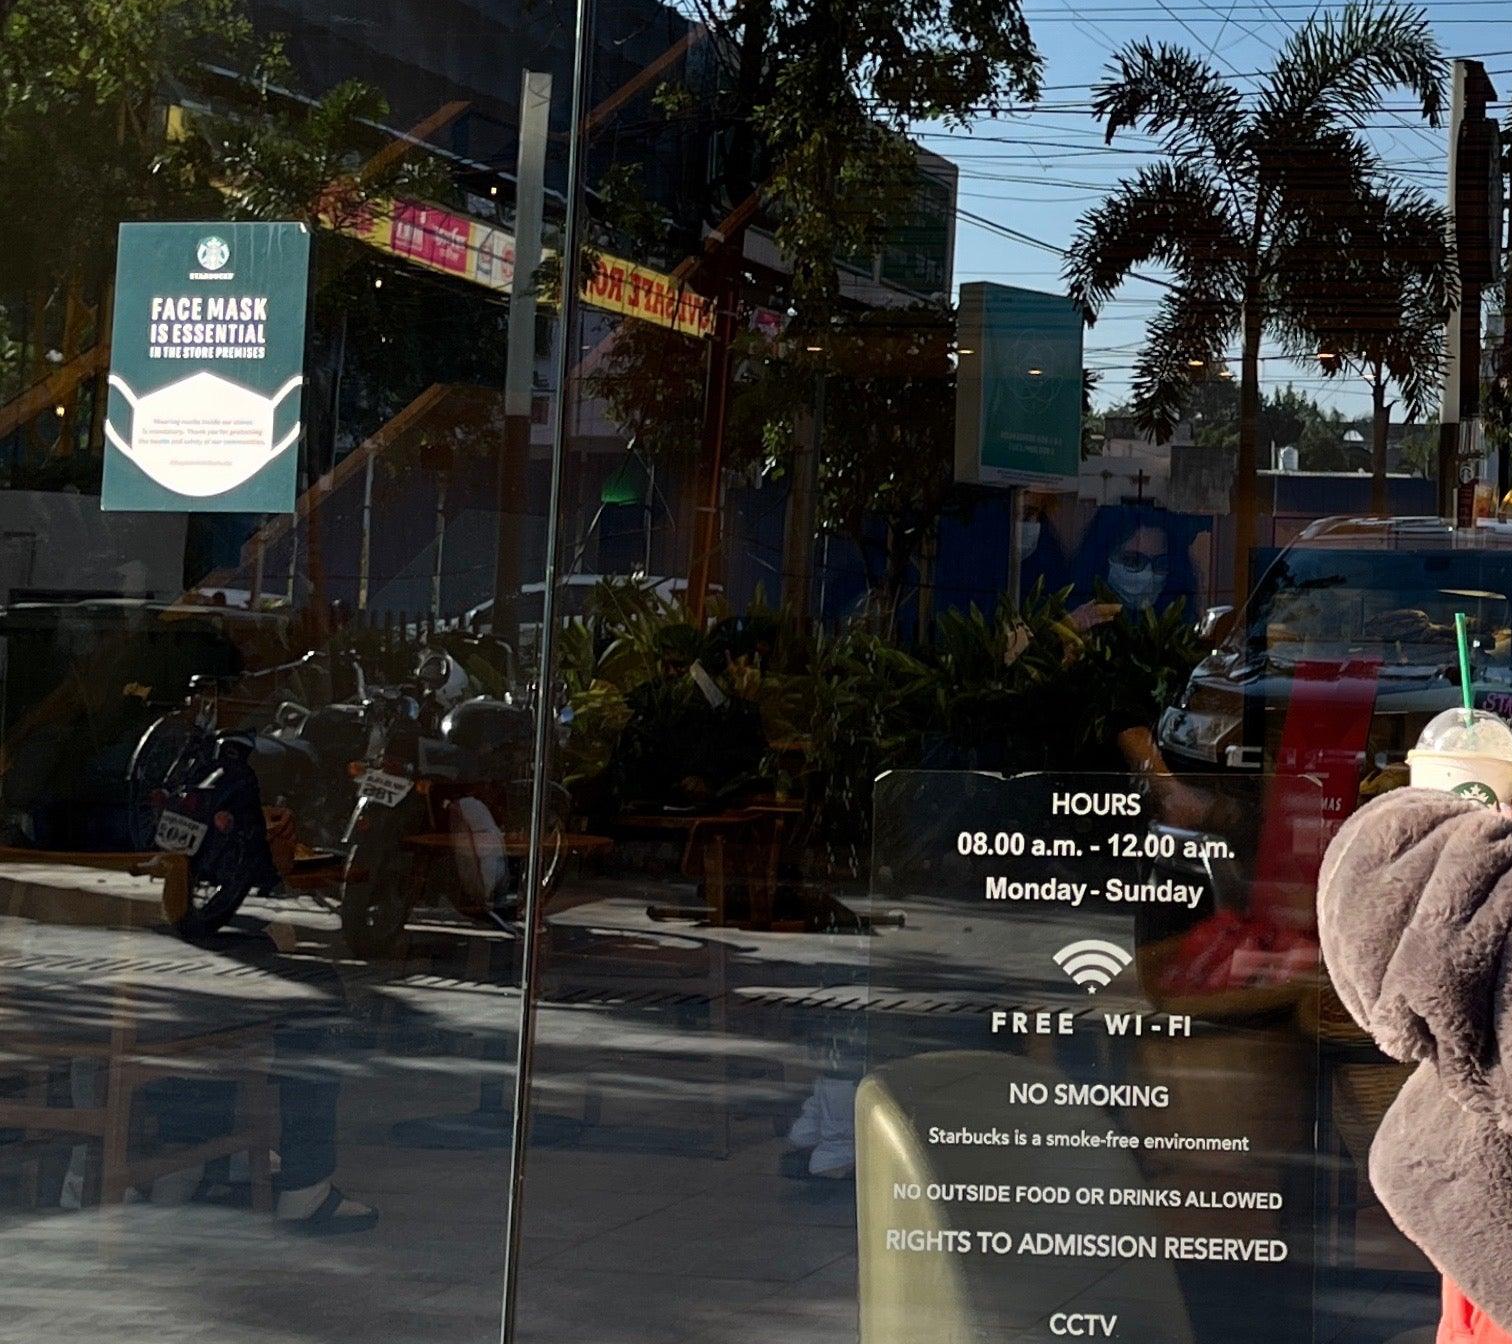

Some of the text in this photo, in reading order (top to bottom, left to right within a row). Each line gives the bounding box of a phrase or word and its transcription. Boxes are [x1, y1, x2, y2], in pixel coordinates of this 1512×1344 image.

[151, 297, 267, 321] FACE MASK
[150, 323, 265, 343] IS ESSENTIAL
[149, 346, 265, 358] IN THE STORE PREMISES
[1052, 792, 1141, 816] HOURS
[957, 831, 1025, 856] 08.00
[1031, 838, 1083, 856] a.m.
[1107, 833, 1175, 857] 12.00
[1183, 839, 1235, 858] a.m.
[985, 877, 1087, 906] Monday
[1105, 878, 1204, 908] Sunday
[991, 1012, 1074, 1034] FREE
[1009, 1083, 1169, 1107] NO SMOKING
[928, 1126, 1249, 1151] Starbucks is a smoke-free environment
[893, 1183, 1283, 1209] NO OUTSIDE FOOD OR DRINKS ALLOWED
[886, 1229, 1288, 1262] RIGHTS TO ADMISSION RESERVED
[1049, 1313, 1117, 1336] CCTV
